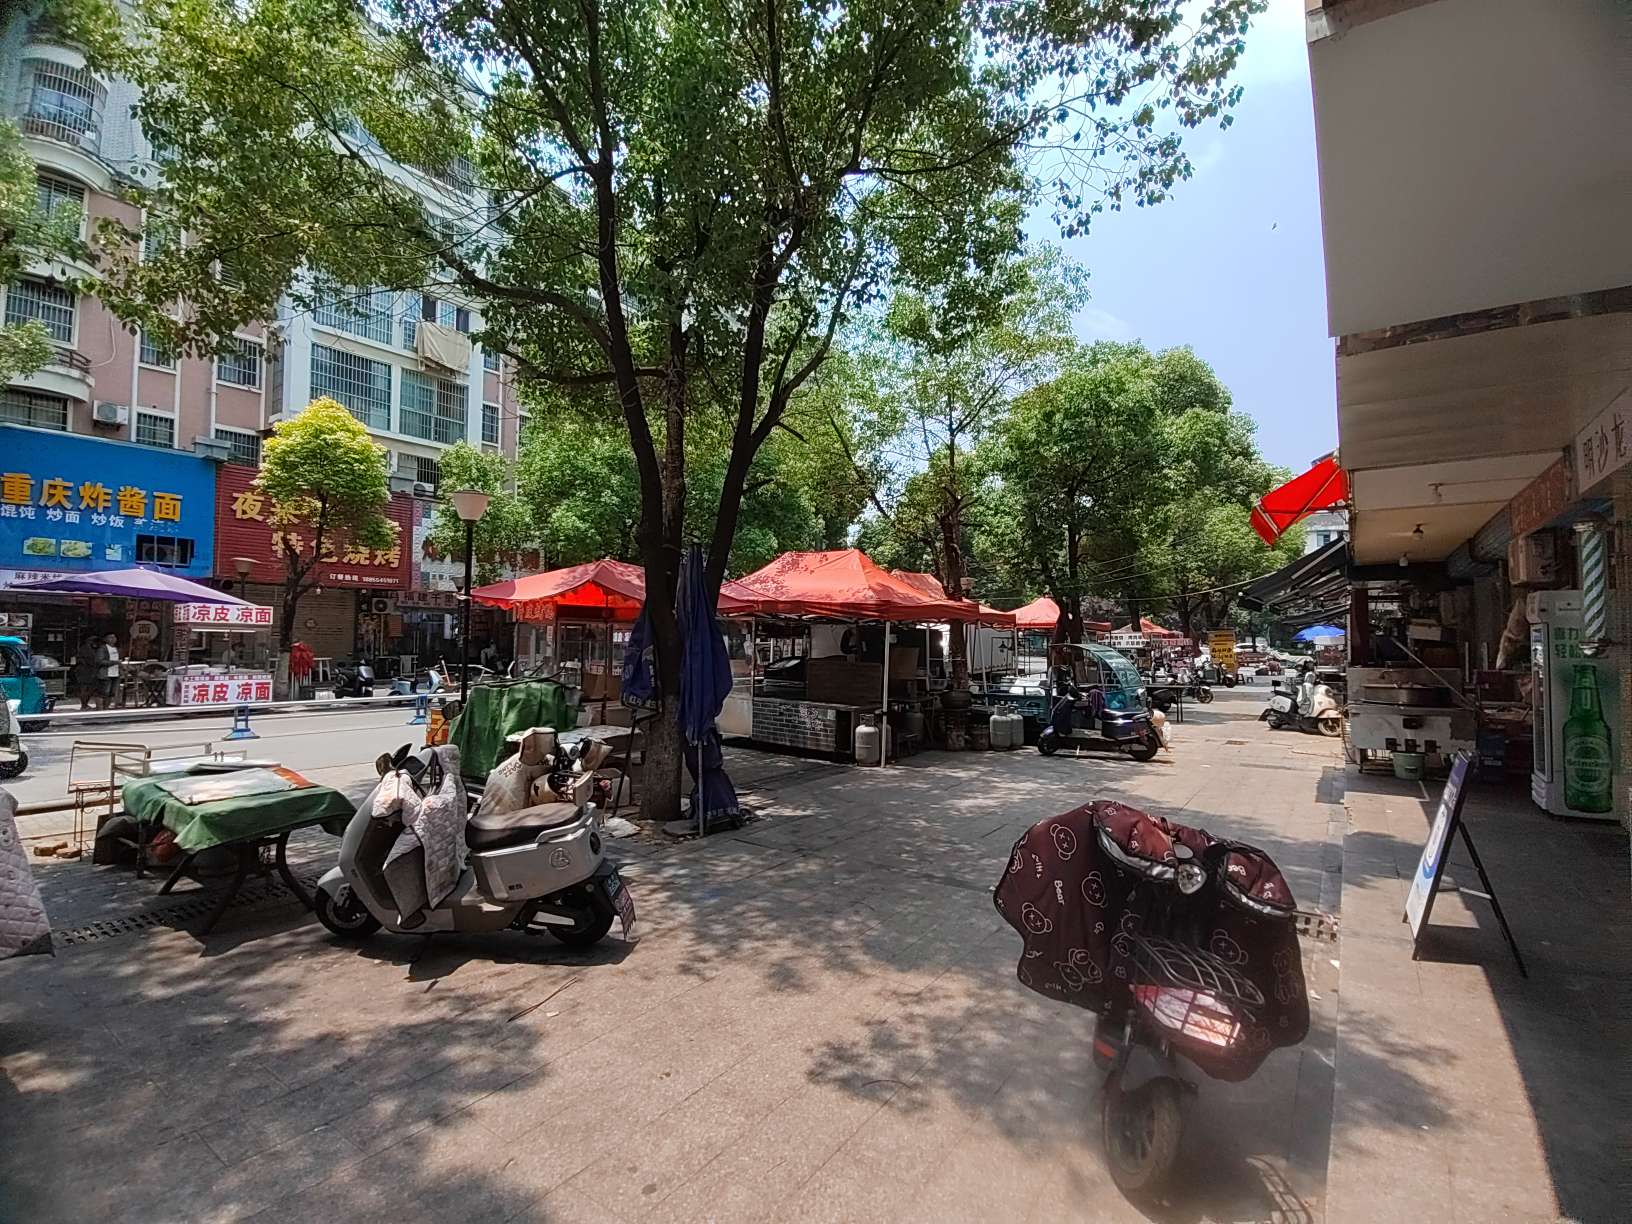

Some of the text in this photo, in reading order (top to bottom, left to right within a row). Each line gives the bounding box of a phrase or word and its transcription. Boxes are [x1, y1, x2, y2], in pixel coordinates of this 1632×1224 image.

[0, 472, 183, 522] 重庆炸酱面
[46, 508, 81, 524] 炒面
[91, 512, 125, 528] 炒饭
[192, 605, 230, 621] 凉皮
[236, 606, 272, 623] 凉面
[192, 683, 229, 703] 凉皮
[236, 682, 271, 701] 凉面
[1054, 880, 1065, 906] Bear
